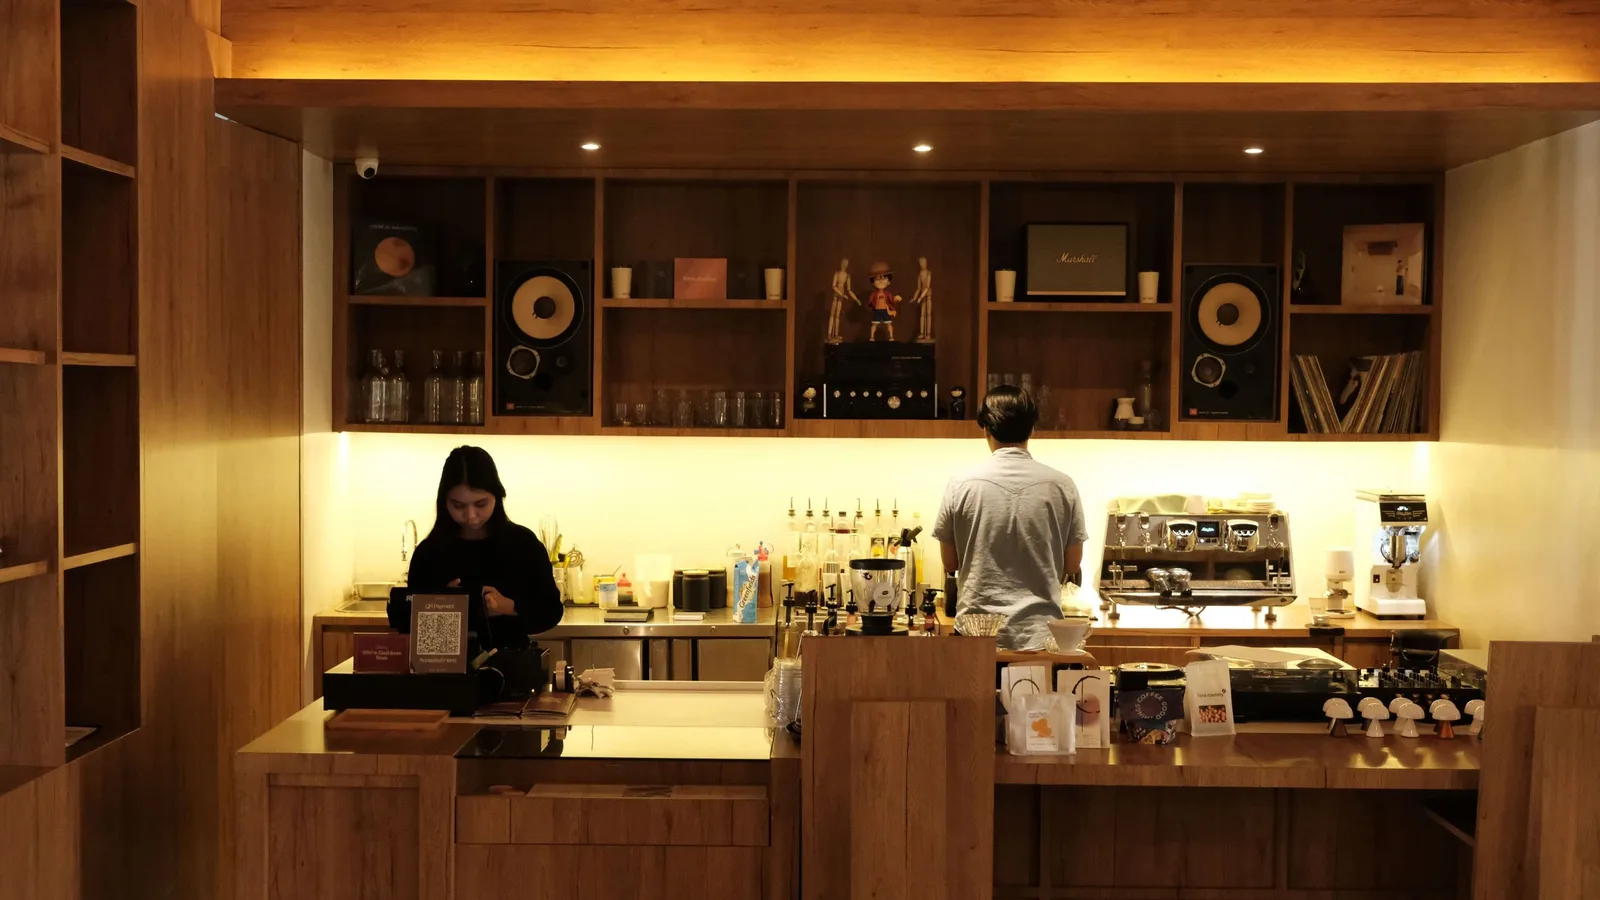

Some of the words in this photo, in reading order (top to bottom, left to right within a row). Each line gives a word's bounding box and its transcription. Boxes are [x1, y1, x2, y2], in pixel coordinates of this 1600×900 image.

[1056, 252, 1098, 264] Marshall
[738, 575, 756, 609] Greenfields
[1136, 692, 1164, 703] COFFEE
